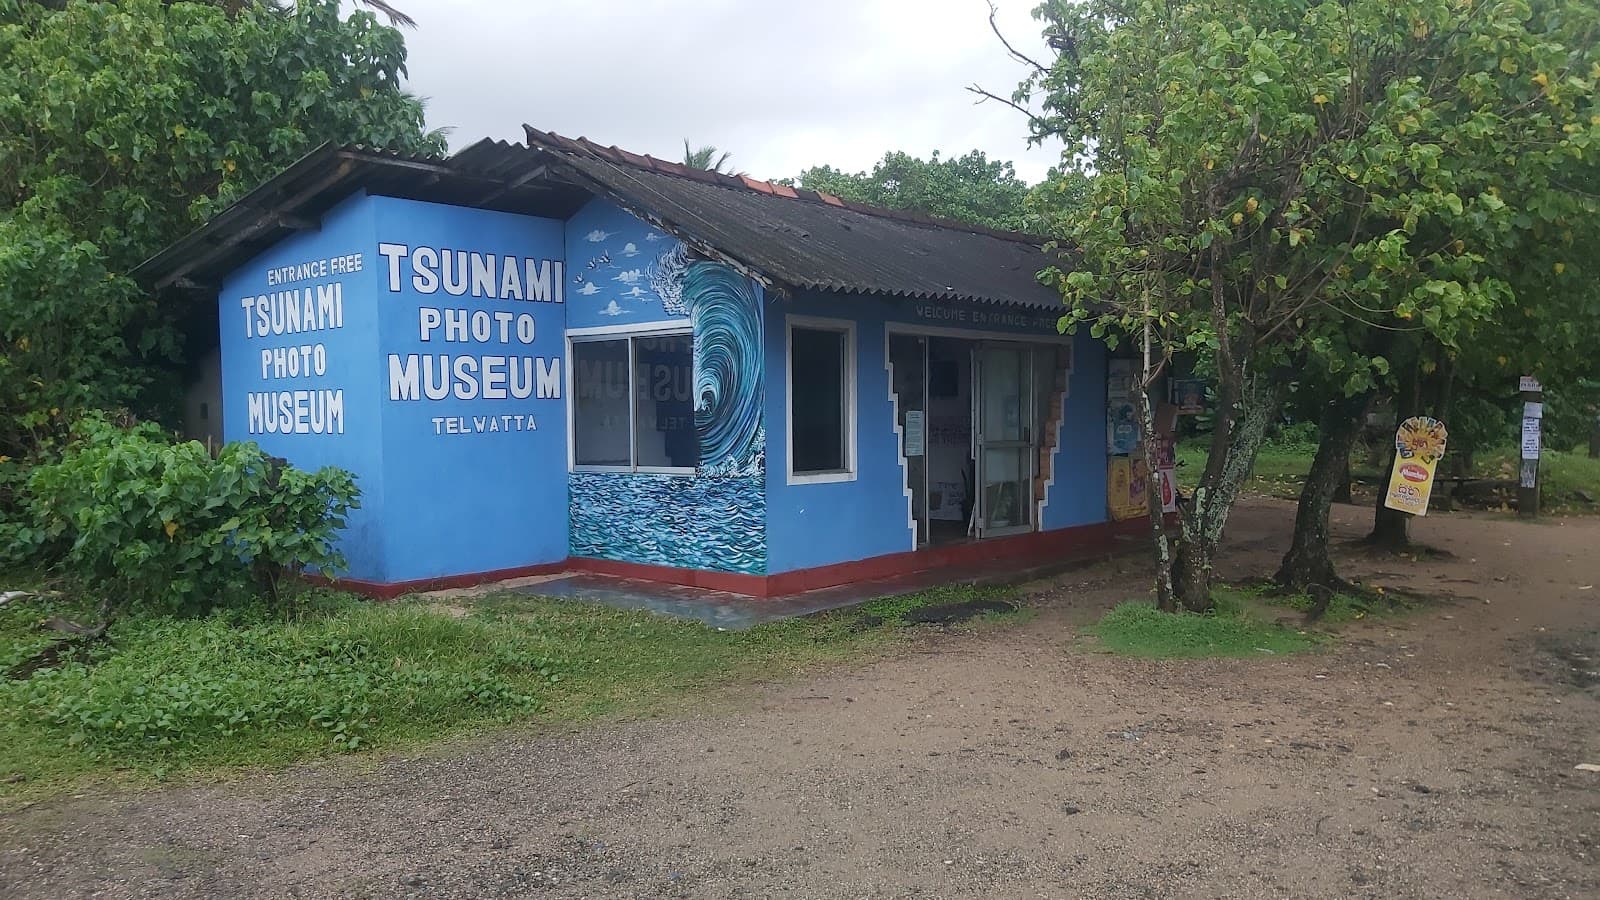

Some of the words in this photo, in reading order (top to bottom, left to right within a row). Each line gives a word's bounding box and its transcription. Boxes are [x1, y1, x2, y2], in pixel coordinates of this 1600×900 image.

[267, 259, 327, 286] ENTRANCE
[330, 253, 363, 275] FREE
[378, 242, 564, 303] TSUNAMI
[241, 282, 344, 338] TSUNAMI
[419, 307, 535, 344] PHOTO
[261, 343, 326, 380] PHOTO
[388, 353, 562, 401] MUSEUM
[248, 389, 344, 434] MUSEUM
[431, 415, 538, 435] TELWATTA
